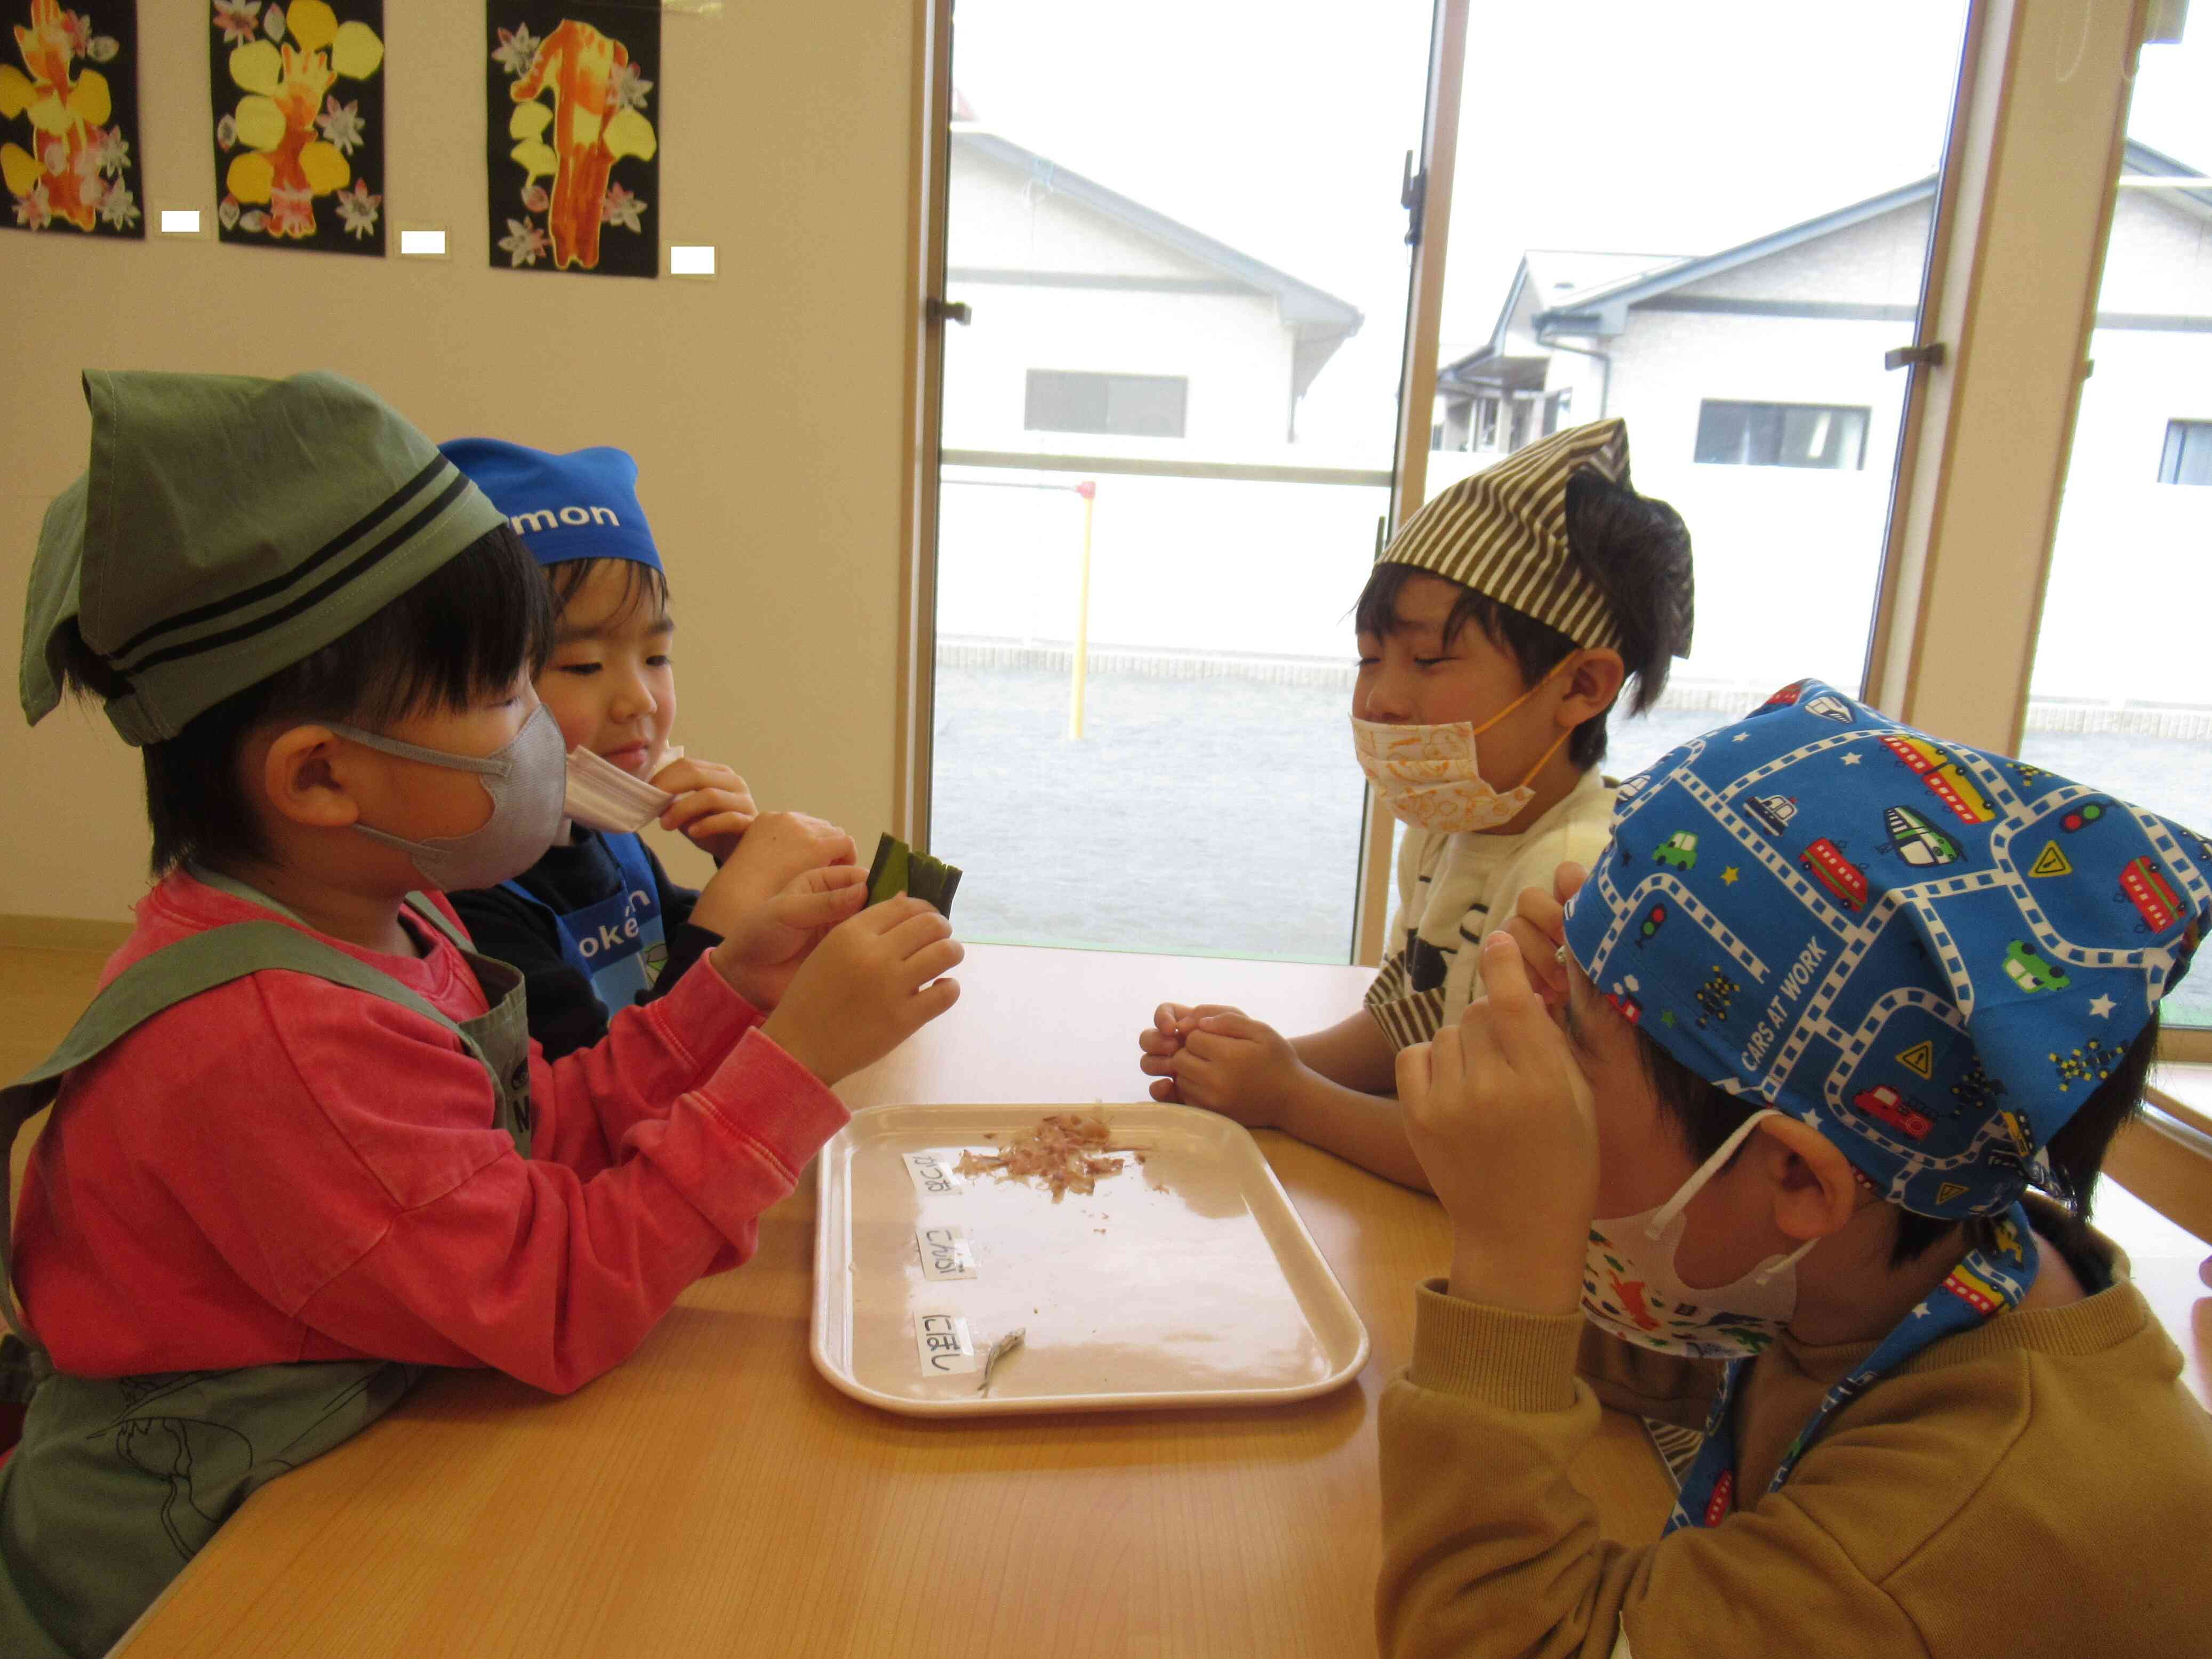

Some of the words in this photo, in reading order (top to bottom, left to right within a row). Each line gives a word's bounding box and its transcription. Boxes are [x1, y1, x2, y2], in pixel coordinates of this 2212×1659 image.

[510, 506, 620, 535] mon
[1741, 1021, 1775, 1071] CARS
[1767, 995, 1788, 1029] AT
[1779, 936, 1827, 1001] WORK
[912, 1156, 952, 1191] かつお
